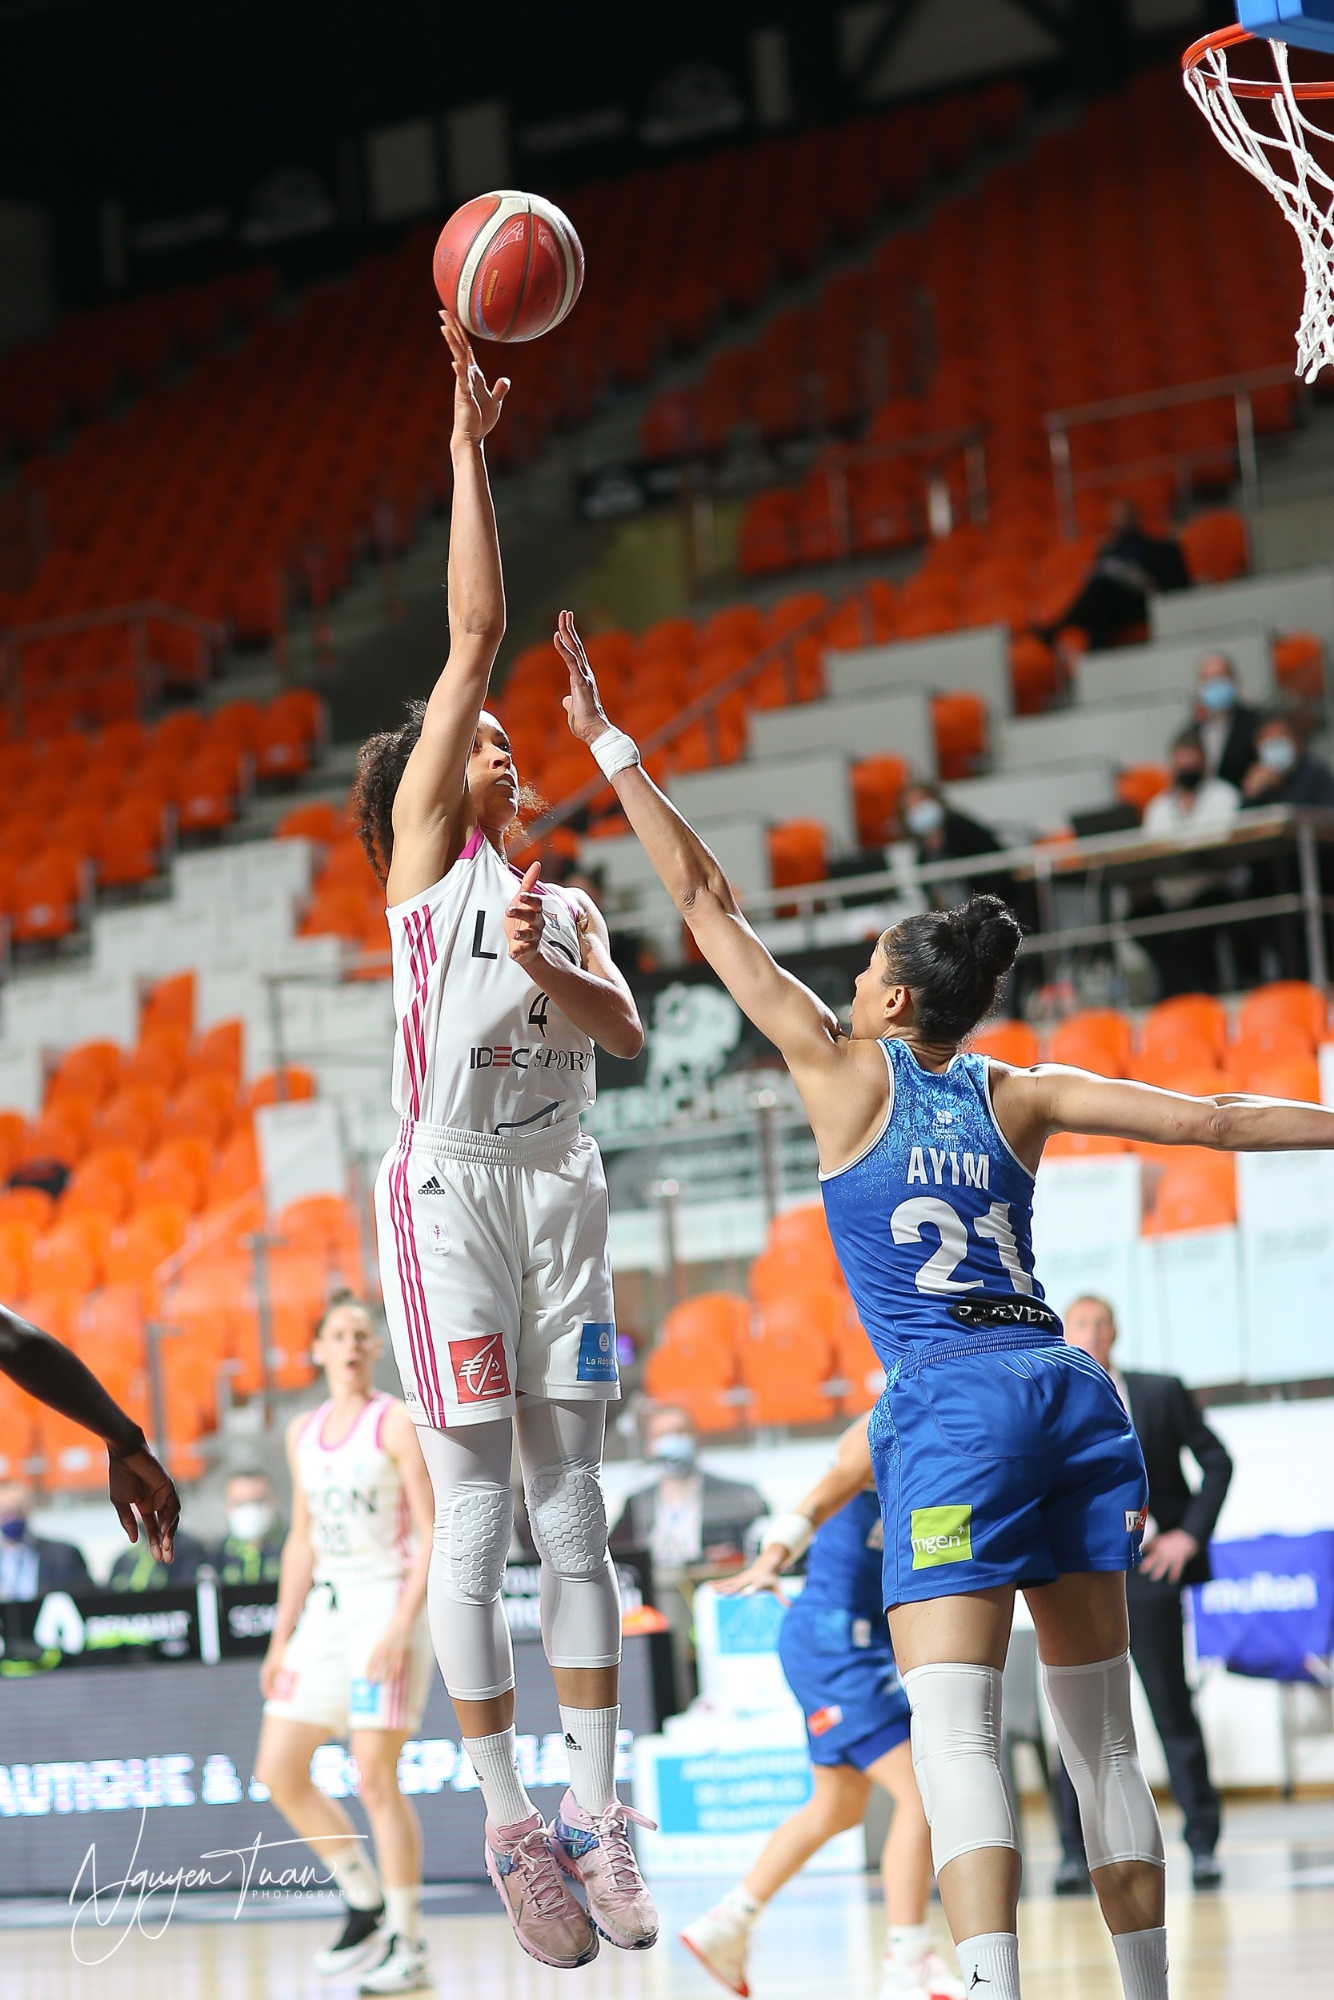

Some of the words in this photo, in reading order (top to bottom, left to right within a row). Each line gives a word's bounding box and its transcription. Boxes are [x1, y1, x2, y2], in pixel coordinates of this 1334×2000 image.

[470, 1046, 530, 1069] IDEC
[534, 1048, 595, 1073] SPORT
[906, 1146, 990, 1191] AYIM
[418, 1188, 446, 1196] adidas
[890, 1196, 1034, 1296] 21
